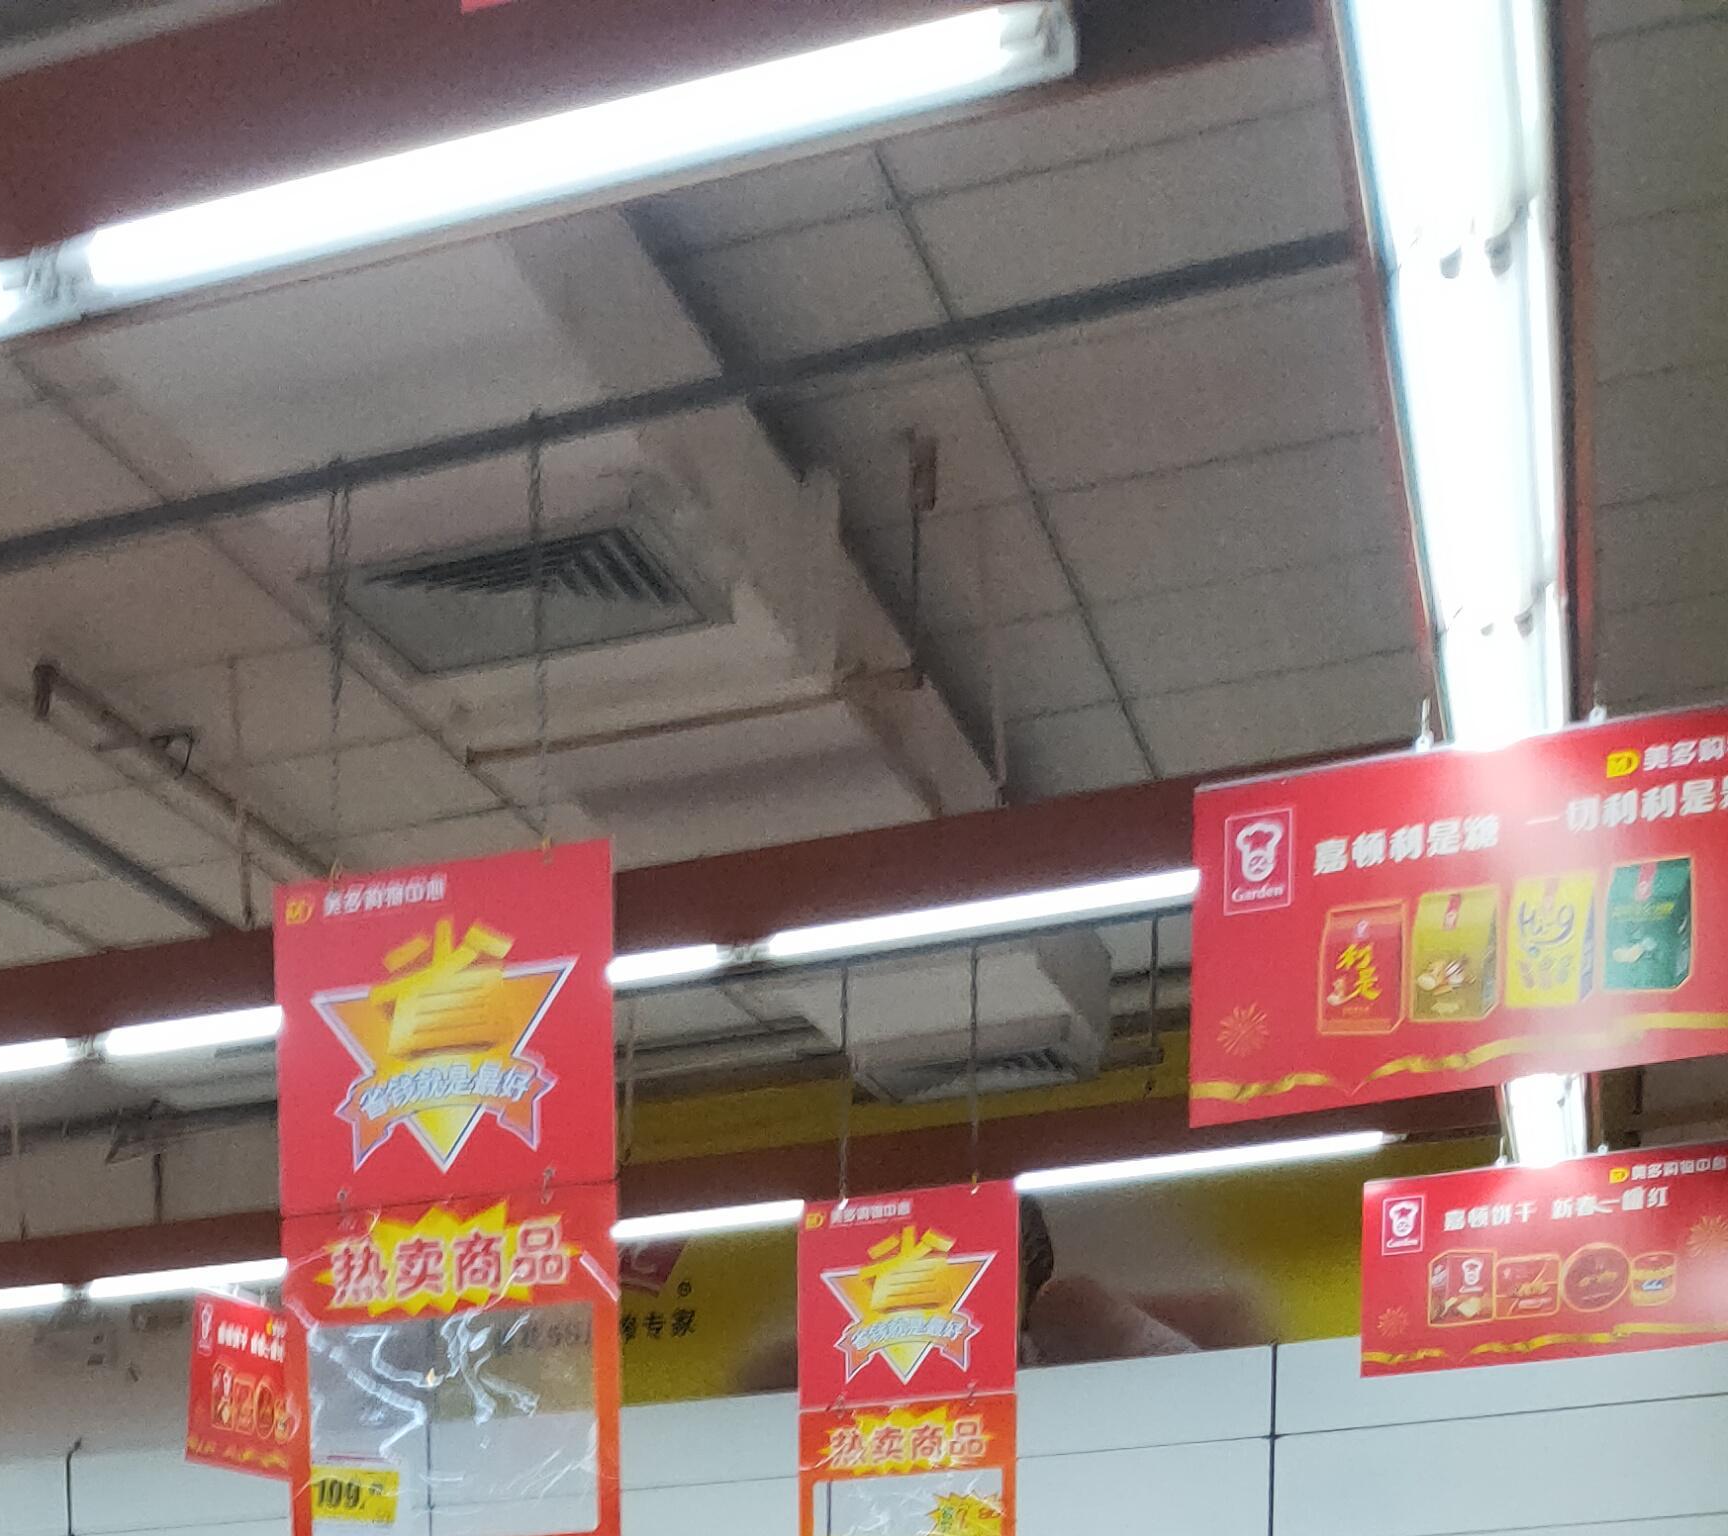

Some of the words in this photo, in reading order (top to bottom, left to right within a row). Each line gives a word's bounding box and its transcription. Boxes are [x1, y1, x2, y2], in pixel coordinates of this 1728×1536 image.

[1231, 883, 1285, 904] Garden
[369, 918, 517, 1058] 省
[357, 1062, 535, 1120] 省钱就是最好
[328, 1214, 572, 1308] 热卖商品
[858, 1225, 956, 1314] 省
[828, 1418, 988, 1468] 热卖商品
